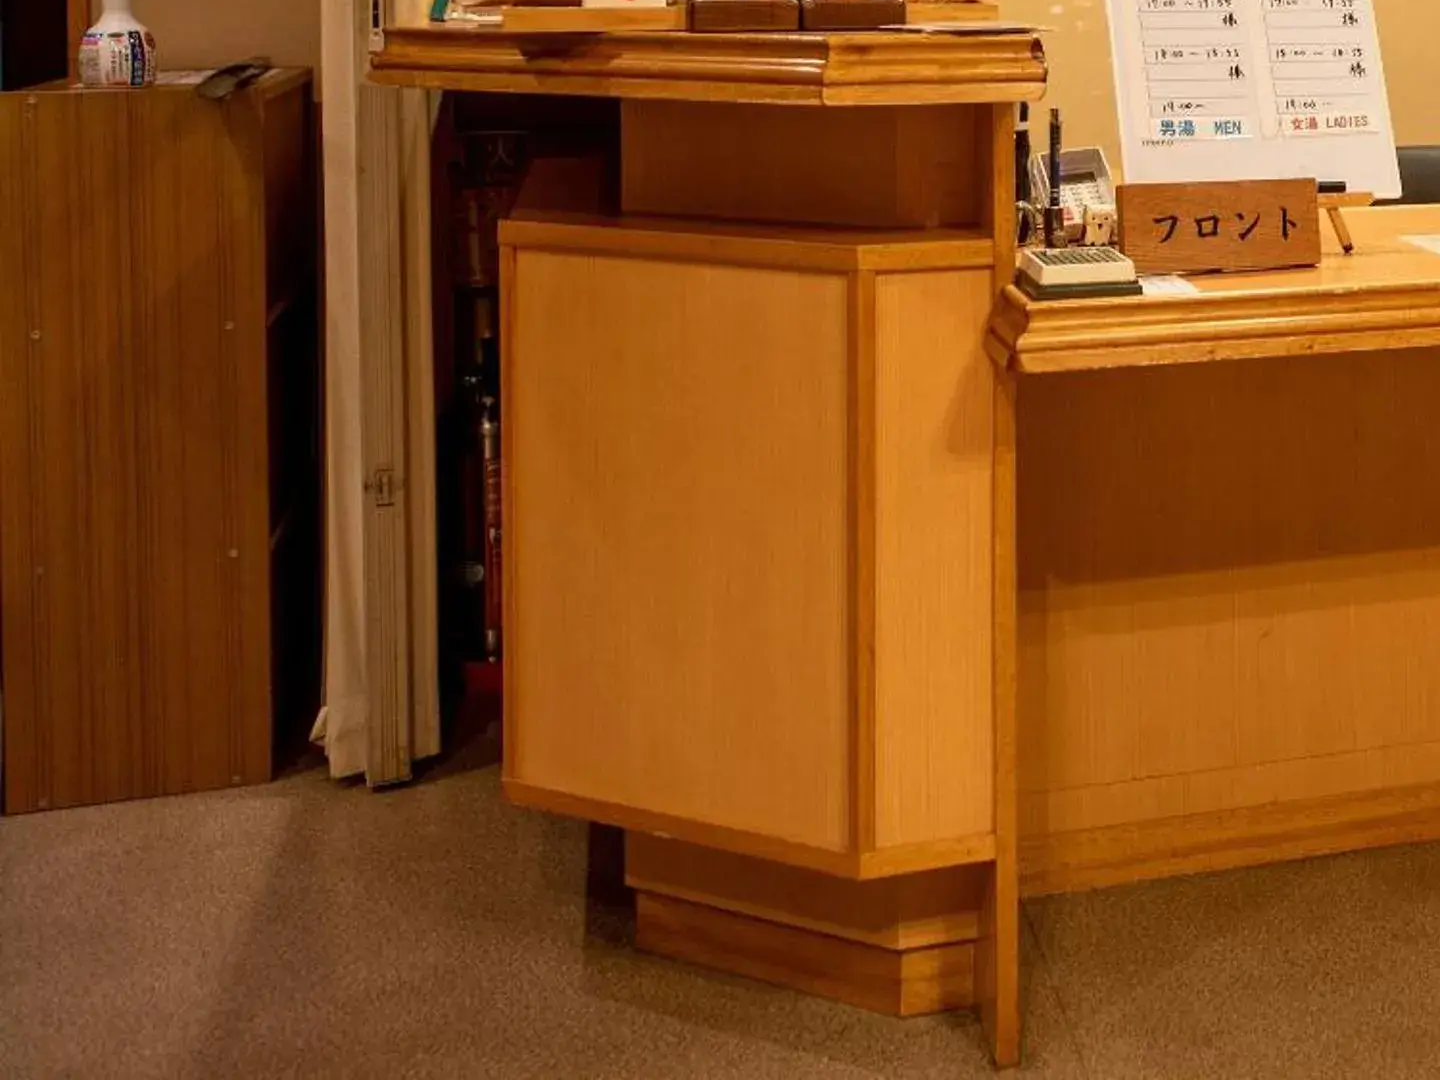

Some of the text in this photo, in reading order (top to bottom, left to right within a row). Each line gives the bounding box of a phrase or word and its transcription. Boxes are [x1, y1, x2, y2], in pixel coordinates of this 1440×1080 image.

[1160, 119, 1242, 137] 男湯 MEN
[1290, 115, 1369, 131] 女湯 LADIES
[1152, 206, 1298, 244] フロント
